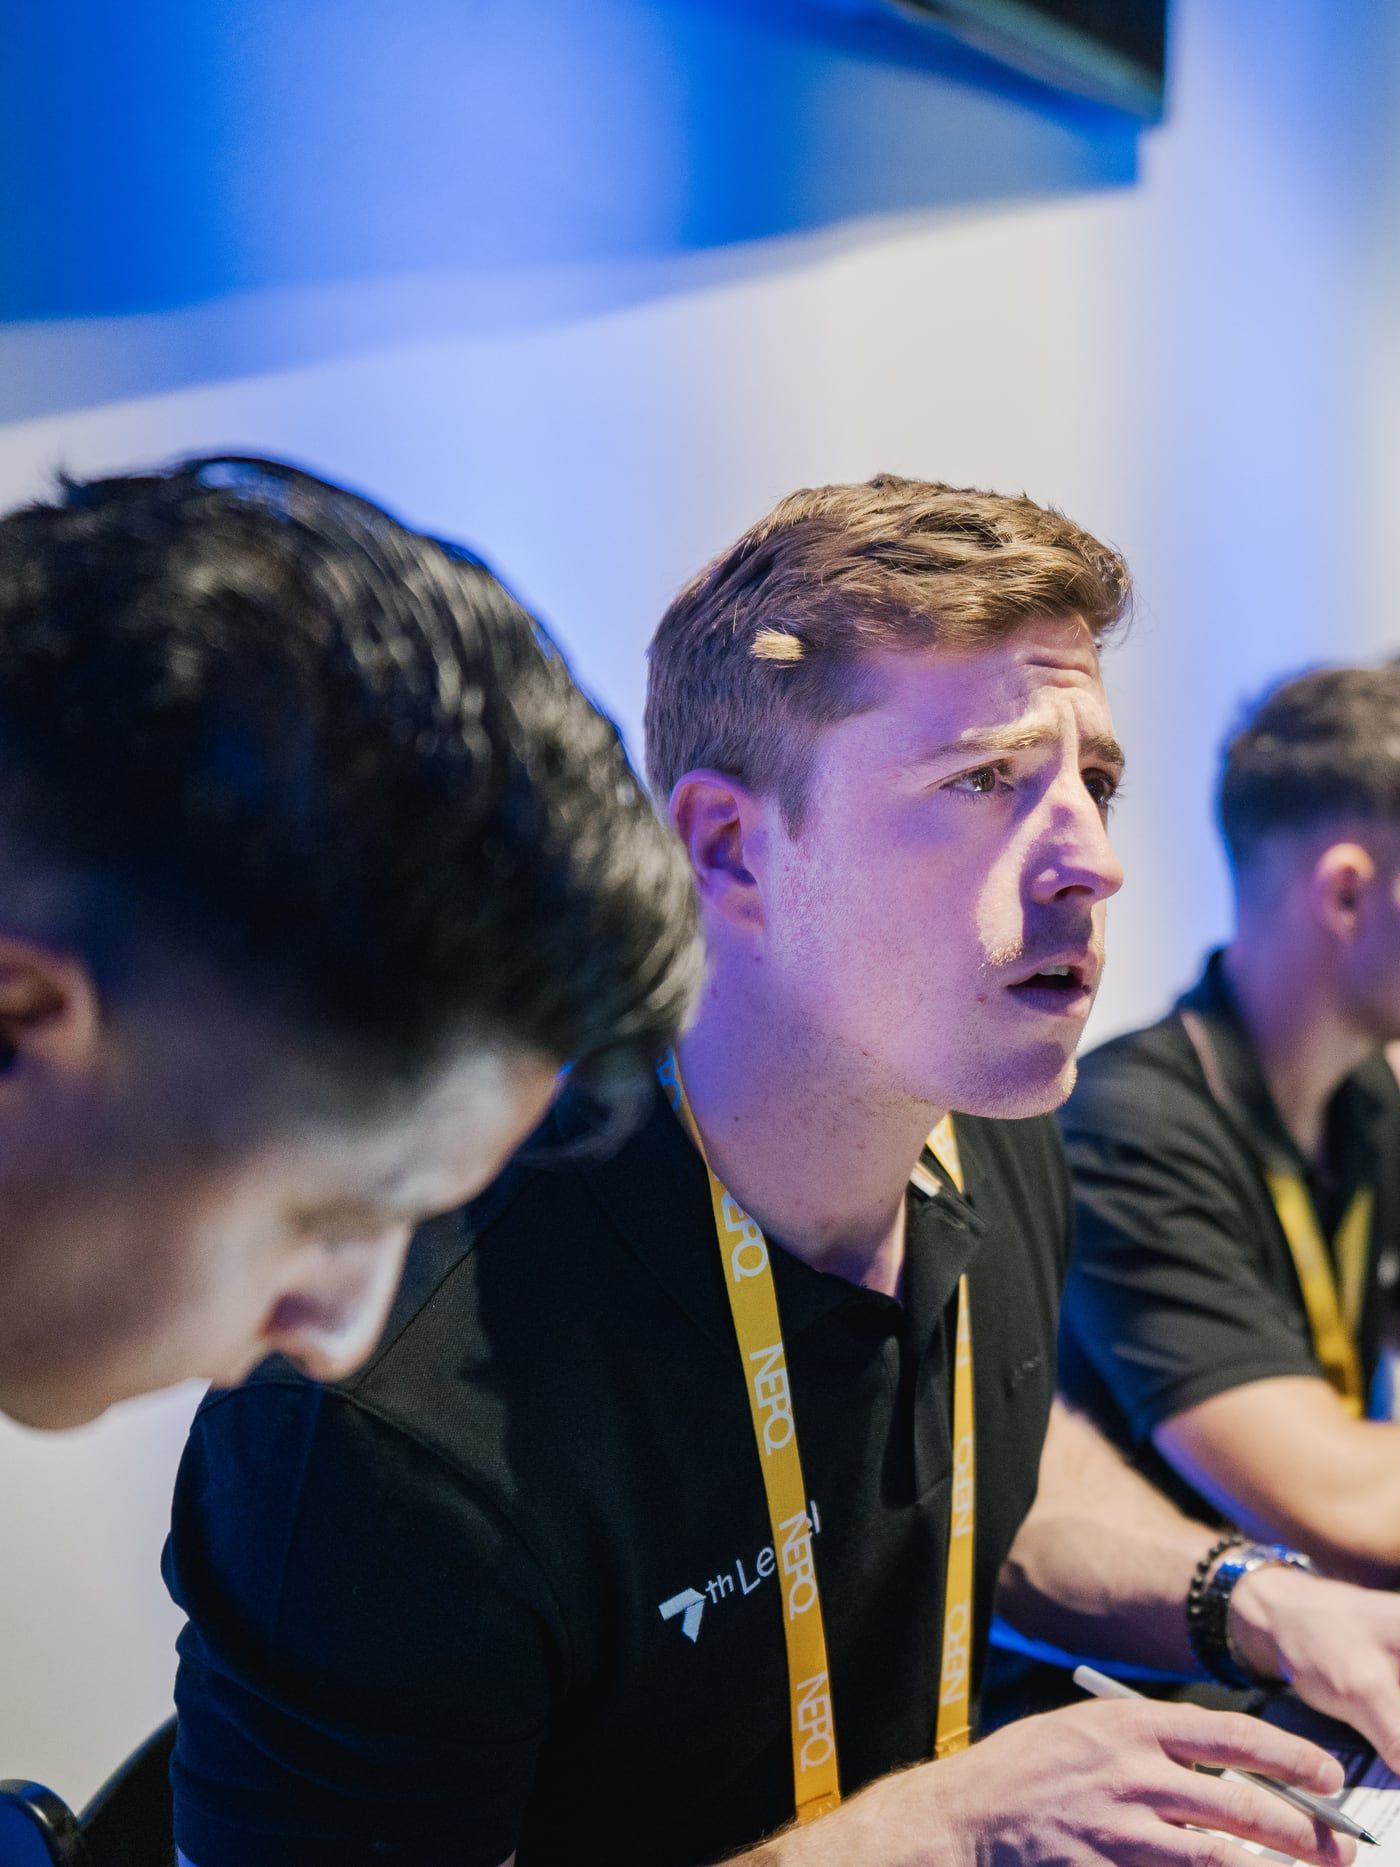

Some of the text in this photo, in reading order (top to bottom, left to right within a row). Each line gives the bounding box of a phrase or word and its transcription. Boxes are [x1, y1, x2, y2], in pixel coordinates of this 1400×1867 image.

[720, 1188, 769, 1283] EPQ
[749, 1342, 795, 1456] NEPQ
[951, 1434, 974, 1538] NEPQ
[735, 1500, 821, 1595] Lel
[778, 1509, 818, 1622] NEPQ
[942, 1601, 971, 1705] NEPQ
[796, 1671, 834, 1774] NEPQ
